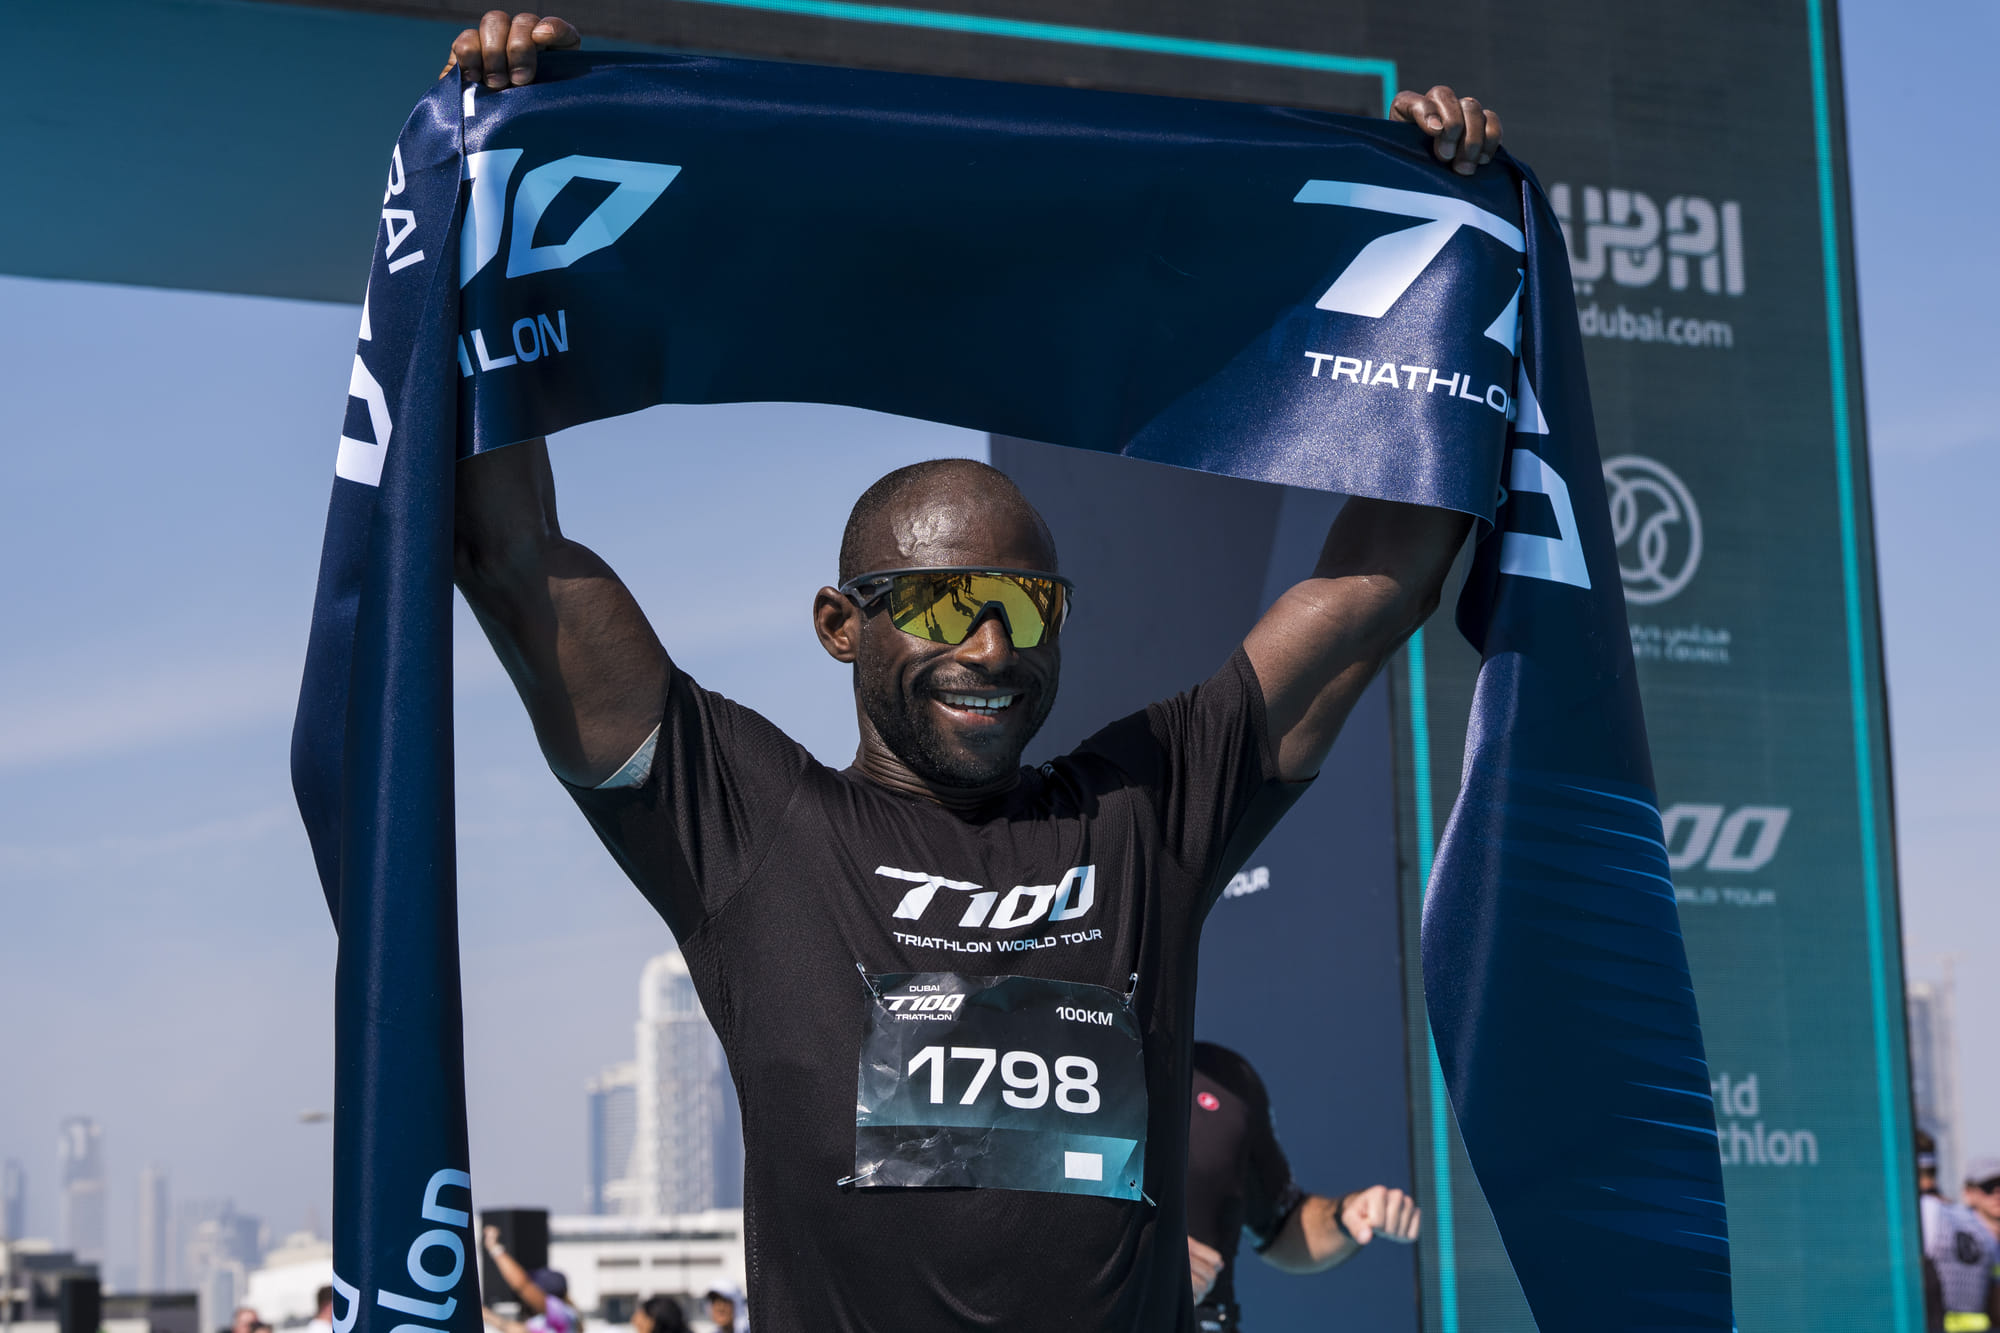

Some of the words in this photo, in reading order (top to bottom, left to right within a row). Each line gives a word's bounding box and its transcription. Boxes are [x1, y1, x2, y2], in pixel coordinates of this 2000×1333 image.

[1304, 351, 1514, 421] TRIATHLO
[874, 864, 1096, 930] T100
[893, 932, 992, 953] TRIATHLON
[997, 937, 1056, 952] WORLD
[1061, 928, 1103, 945] TOUR
[909, 984, 940, 993] DUBAI
[883, 993, 966, 1013] T100
[895, 1013, 952, 1021] TRIATHLON
[1055, 1006, 1113, 1026] 100KM
[908, 1045, 1101, 1114] 1798
